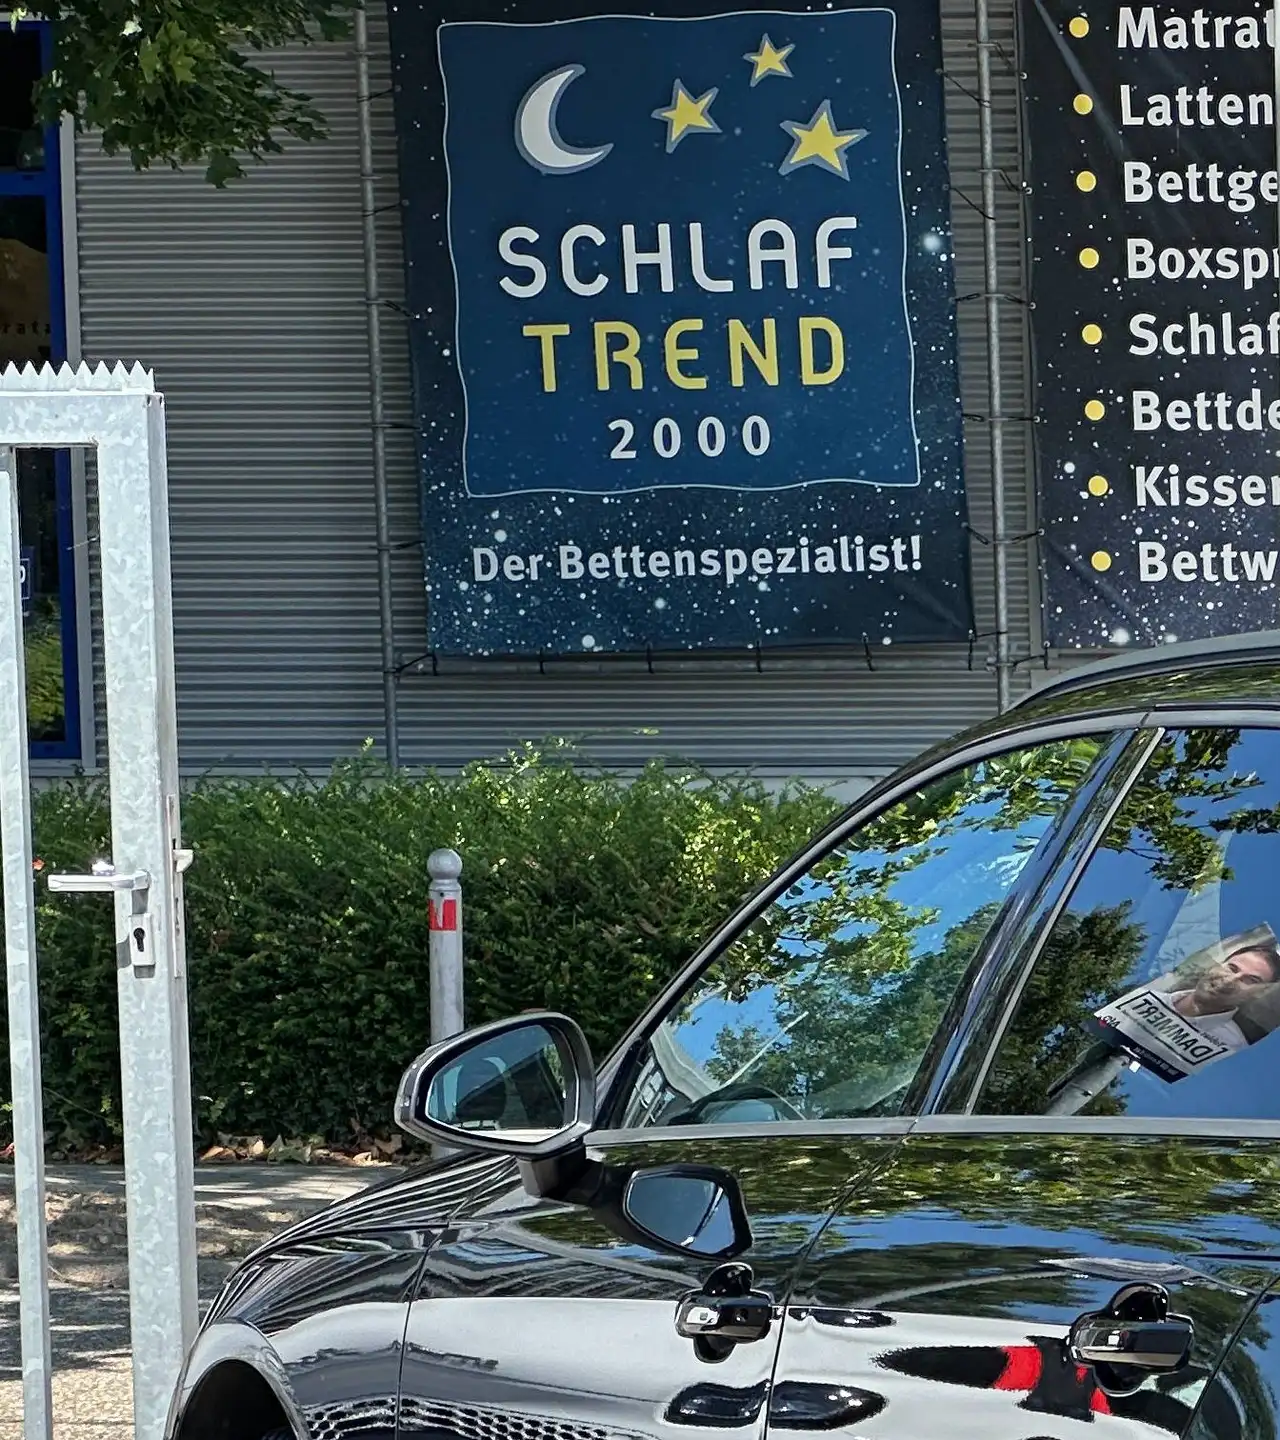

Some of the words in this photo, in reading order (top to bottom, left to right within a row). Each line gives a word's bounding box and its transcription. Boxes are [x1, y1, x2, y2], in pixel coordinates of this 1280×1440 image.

[498, 217, 858, 298] SCHLAF
[522, 317, 846, 393] TREND
[607, 415, 772, 460] 2000
[472, 547, 544, 582] Der
[558, 535, 922, 584] Bettenspezialist!
